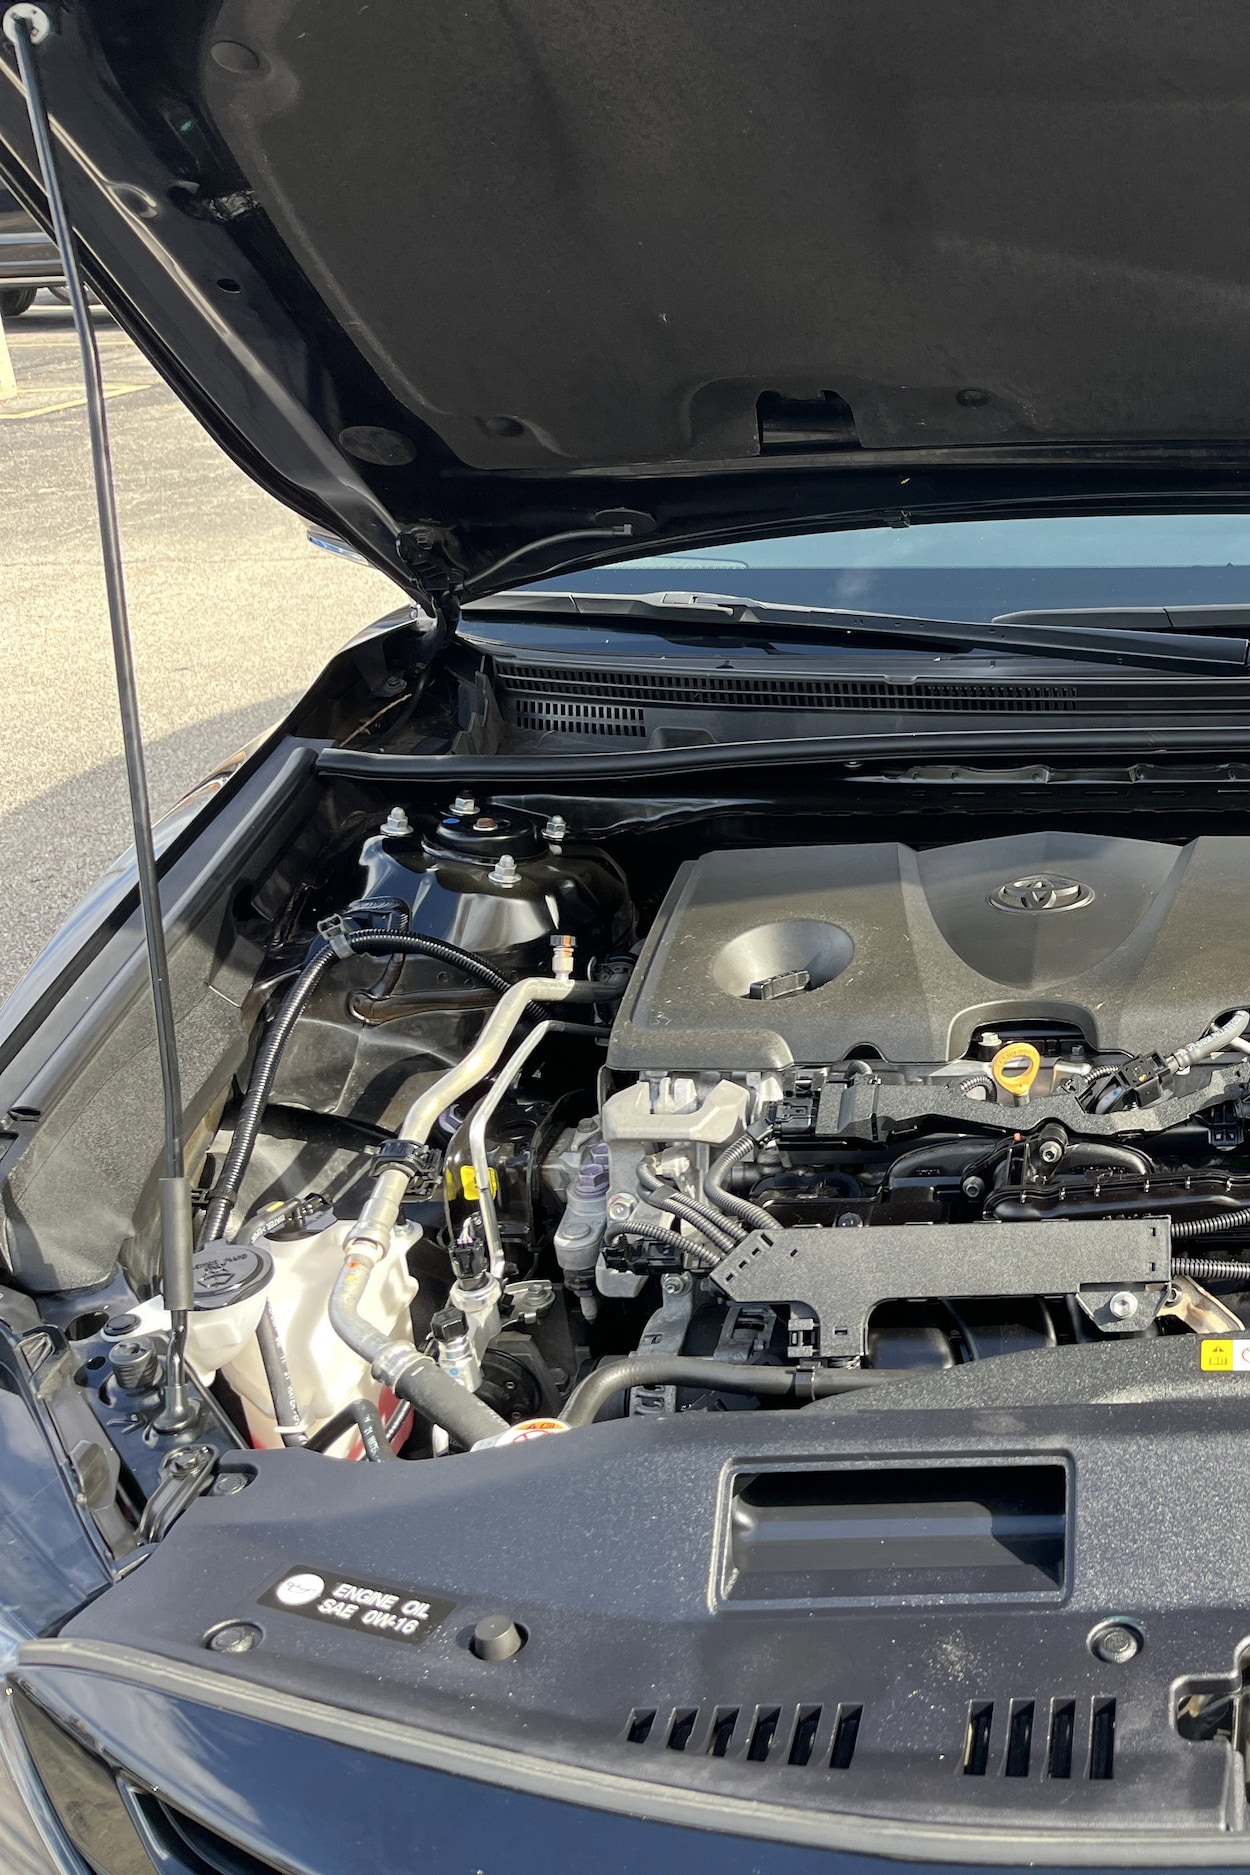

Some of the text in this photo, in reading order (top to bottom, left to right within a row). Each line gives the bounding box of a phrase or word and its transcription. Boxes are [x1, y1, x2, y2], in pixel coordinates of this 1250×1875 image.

[318, 1599, 420, 1635] SAE 0W-16
[332, 1583, 431, 1619] ENGINE OIL
